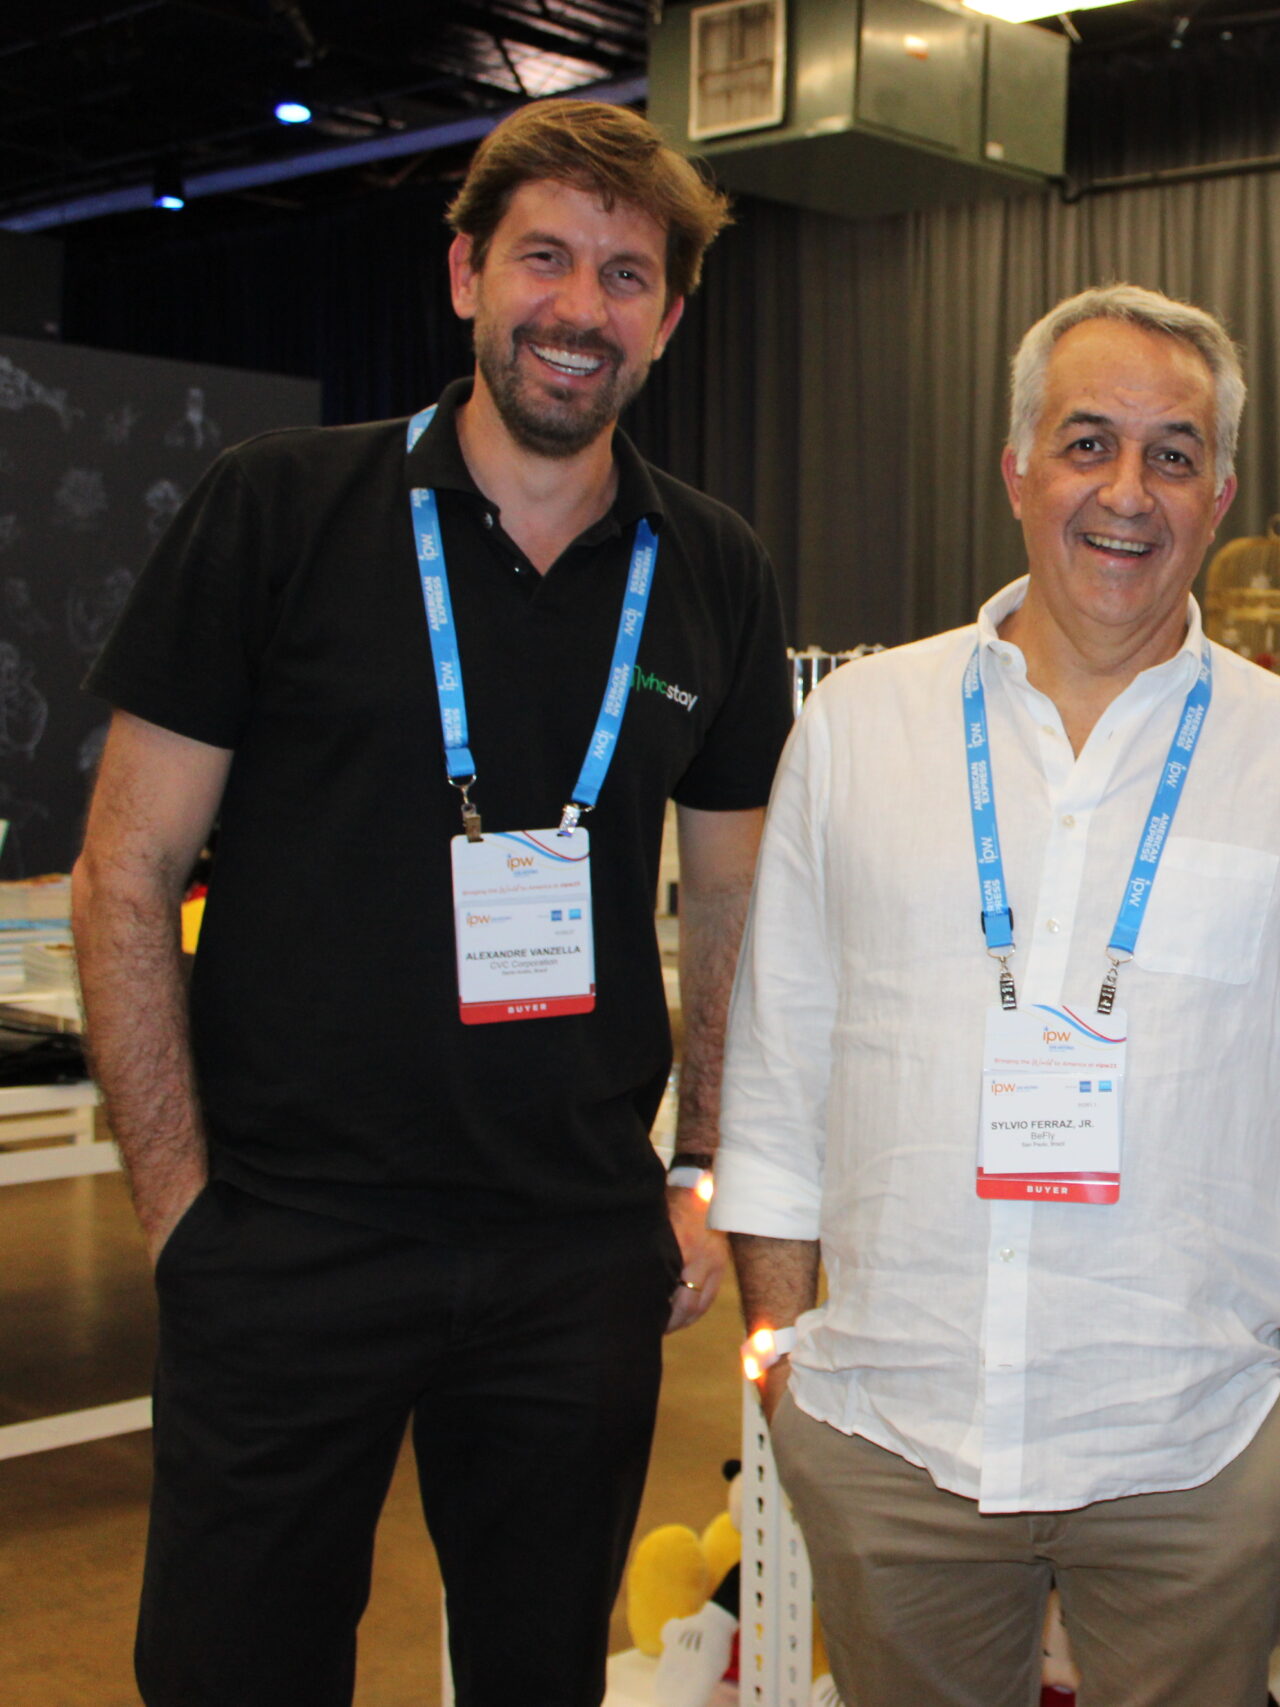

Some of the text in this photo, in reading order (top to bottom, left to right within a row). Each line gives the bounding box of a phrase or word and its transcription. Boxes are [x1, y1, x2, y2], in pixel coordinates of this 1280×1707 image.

[419, 533, 438, 561] ipw
[623, 608, 643, 637] ipw
[438, 661, 458, 691] ipw
[967, 722, 984, 748] ipw
[593, 730, 615, 759] ipw
[1167, 761, 1187, 788] ipw
[978, 836, 998, 864] ipw
[507, 853, 534, 871] ipw
[1128, 877, 1150, 907] ipw
[466, 912, 491, 926] ipw
[465, 945, 581, 961] ALEXANDRE VANZELLA
[490, 958, 558, 970] CVC Corporation
[507, 1003, 547, 1014] BUYER
[1043, 1026, 1072, 1044] ipw
[991, 1080, 1016, 1095] ipw
[991, 1119, 1095, 1130] SYLVIO FERRAZ, JR.
[1026, 1185, 1069, 1195] BUYER
